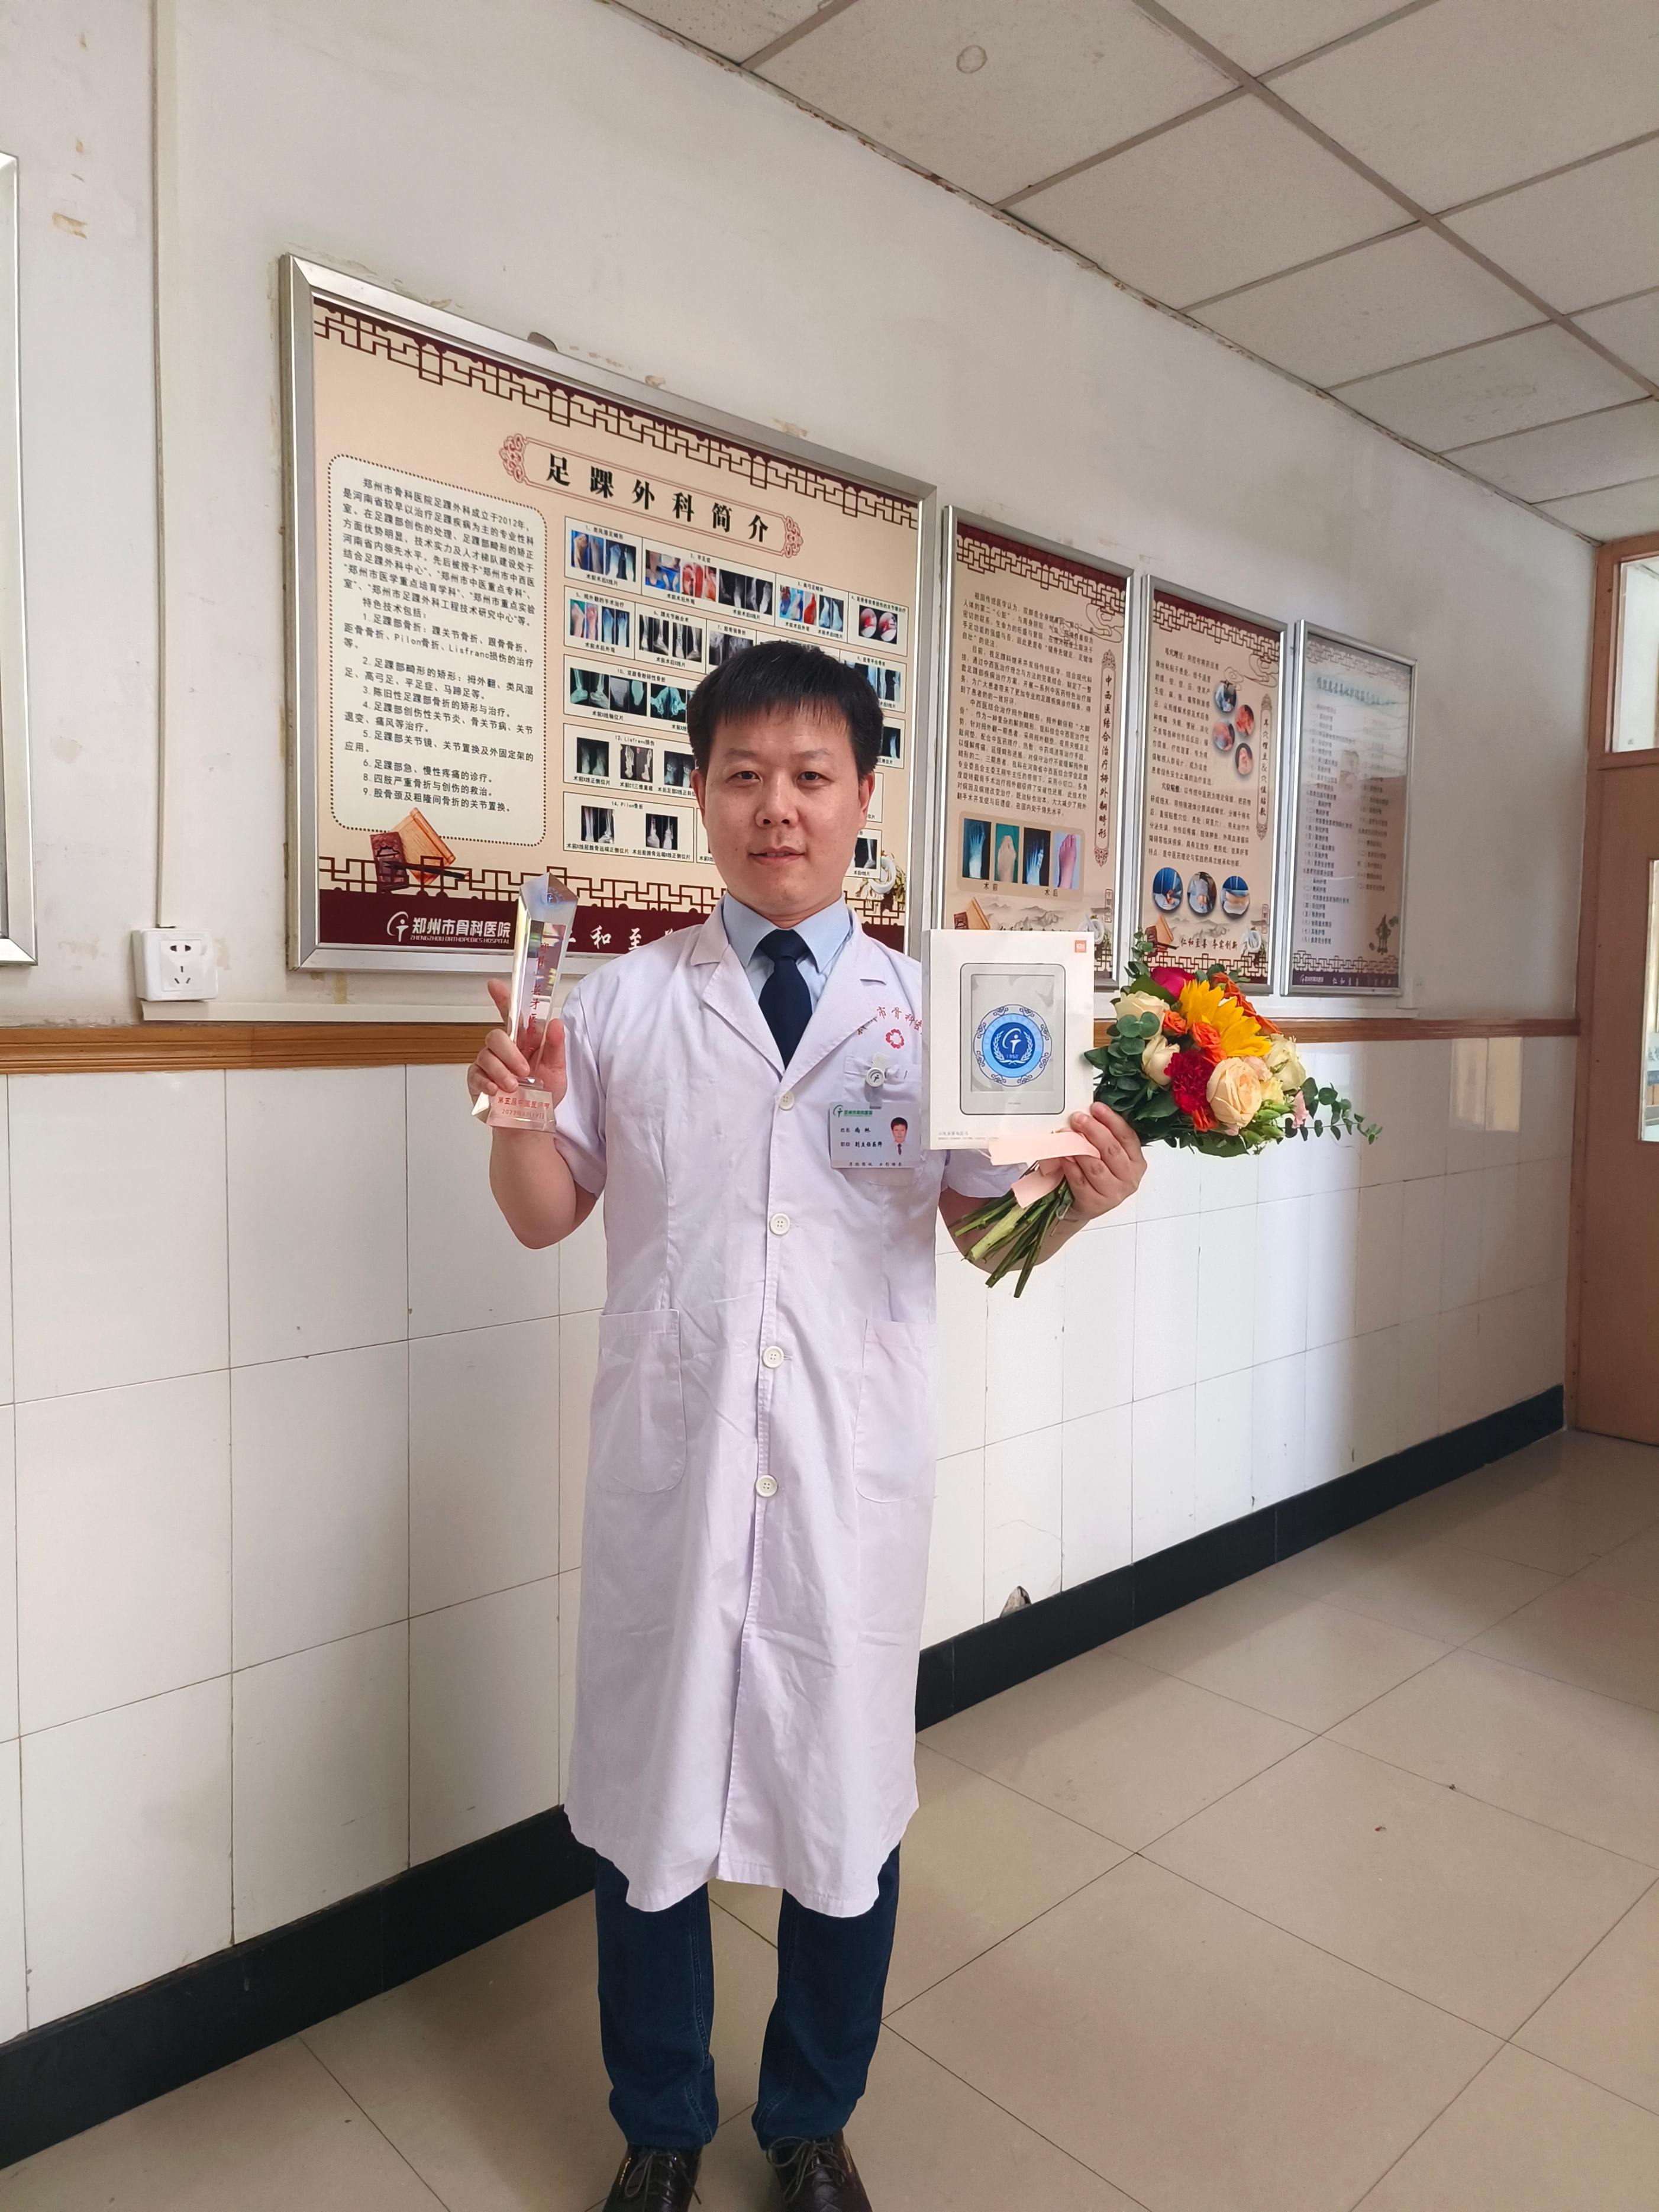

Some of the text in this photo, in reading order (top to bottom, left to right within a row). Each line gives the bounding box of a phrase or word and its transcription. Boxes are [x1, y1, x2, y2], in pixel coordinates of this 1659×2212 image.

[546, 453, 768, 543] 足踝外科简介
[343, 488, 534, 546] 是河南省较早以治疗足踝疾病为主的专业性科
[984, 882, 998, 891] 术前
[1045, 889, 1058, 897] 术后
[412, 917, 511, 938] 郑州市骨科医院
[1181, 937, 1208, 949] 仁和至善
